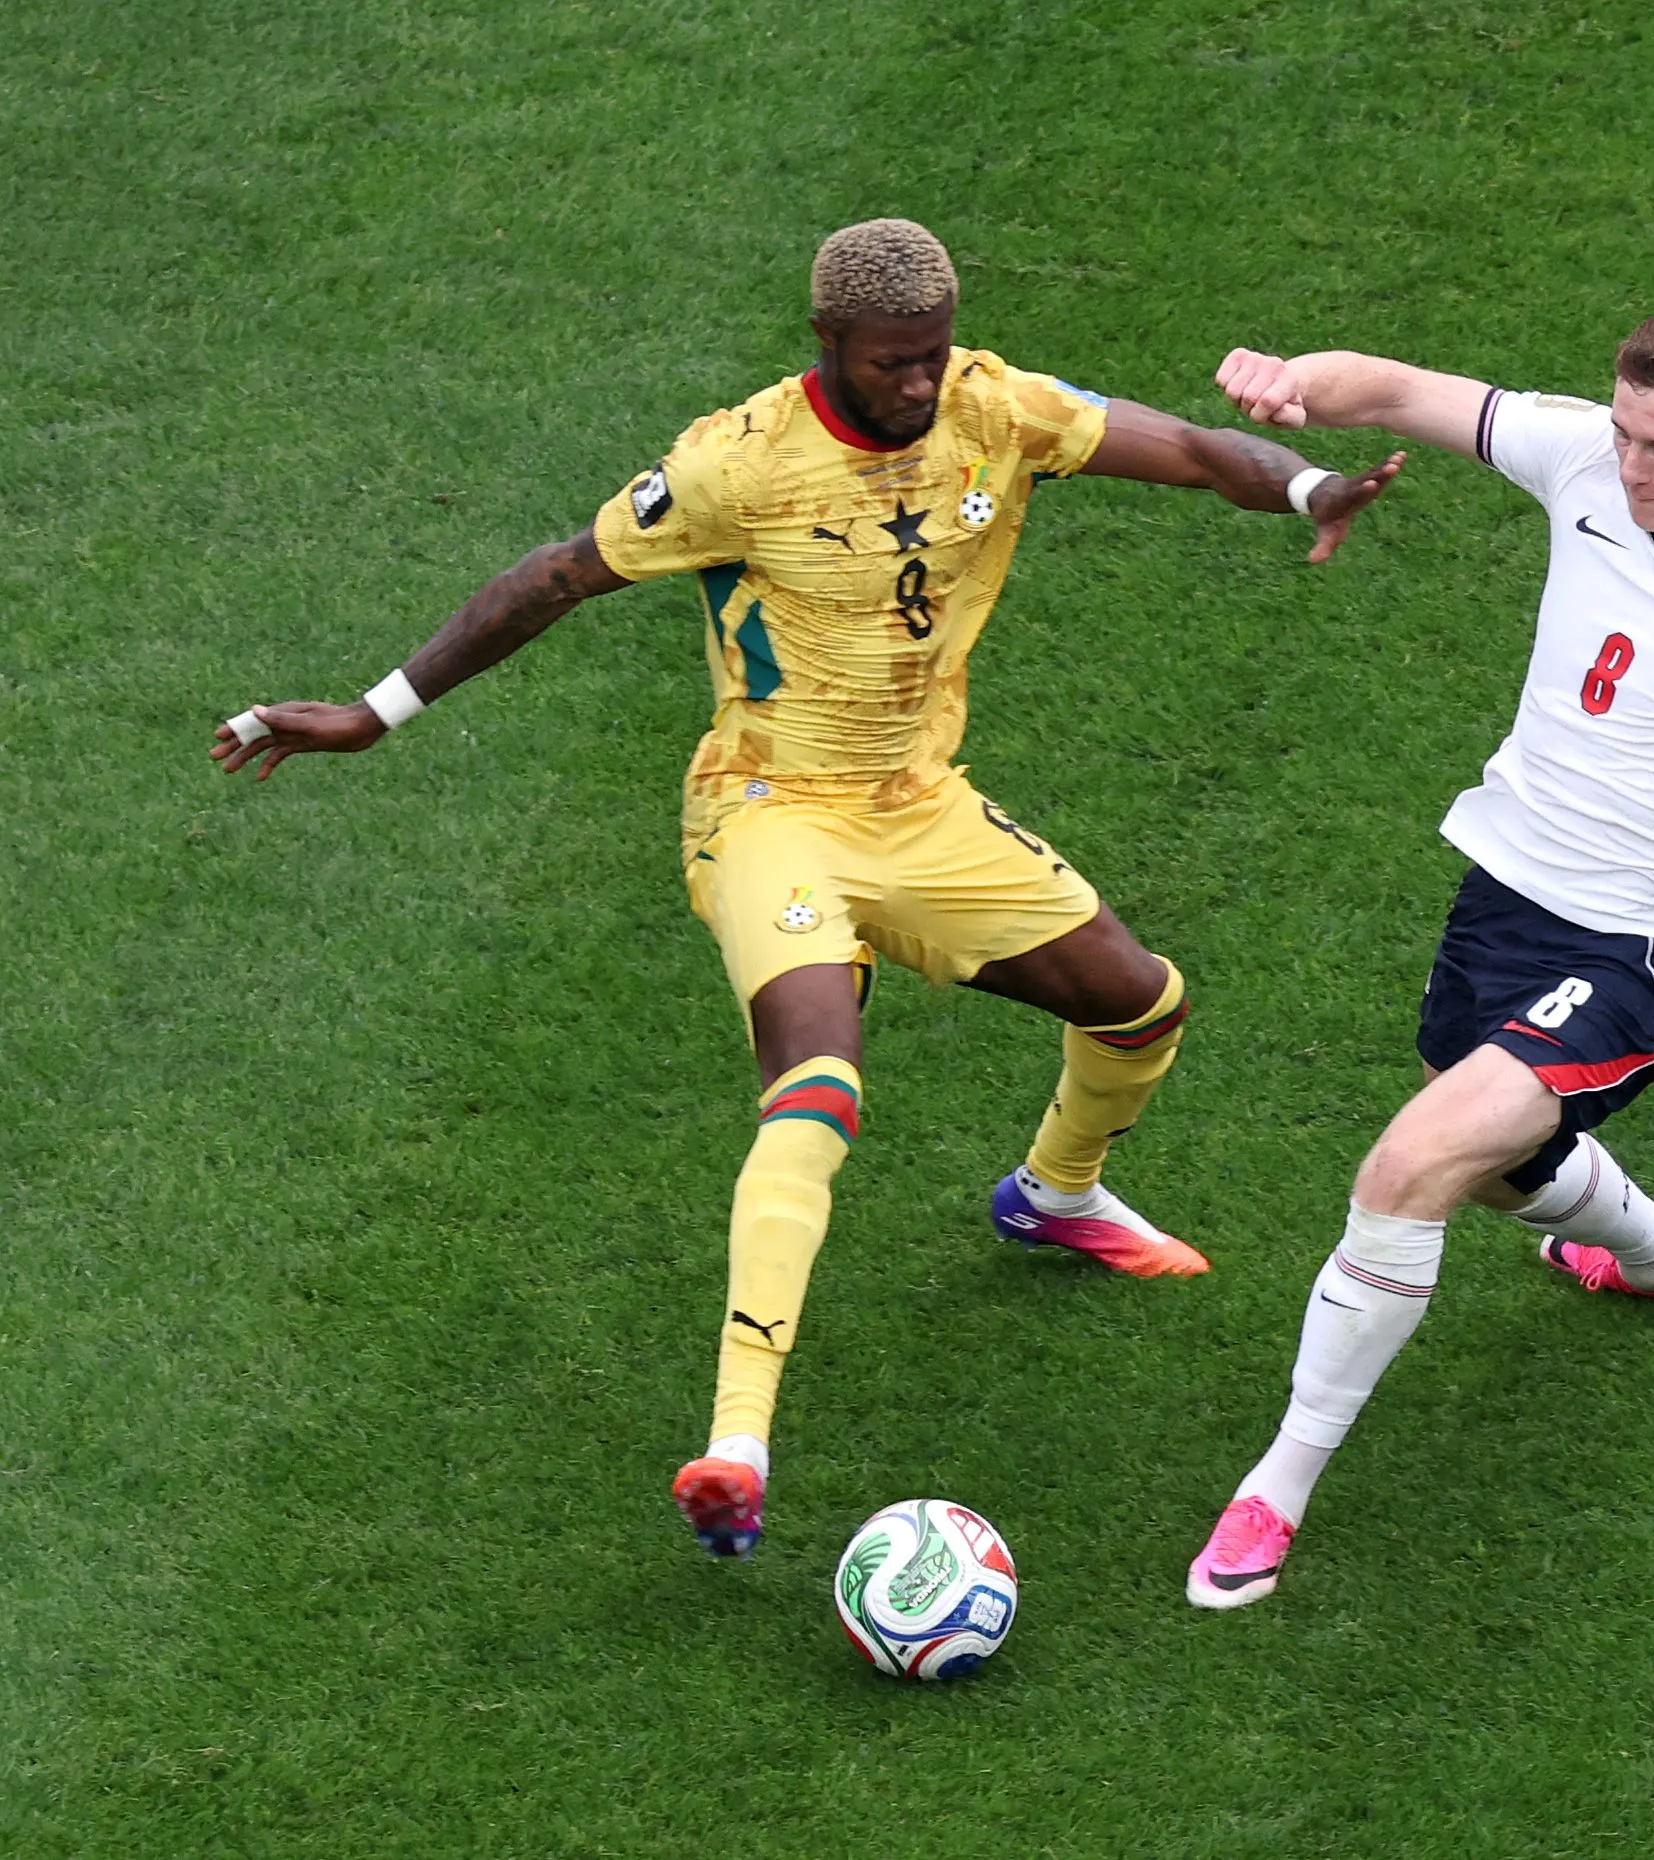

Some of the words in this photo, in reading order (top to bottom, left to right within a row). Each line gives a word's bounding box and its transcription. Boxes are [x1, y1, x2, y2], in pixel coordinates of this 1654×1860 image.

[897, 557, 932, 640] 8
[1580, 631, 1636, 716] 8
[1525, 976, 1593, 1028] 8
[908, 1564, 953, 1608] TRIONDA
